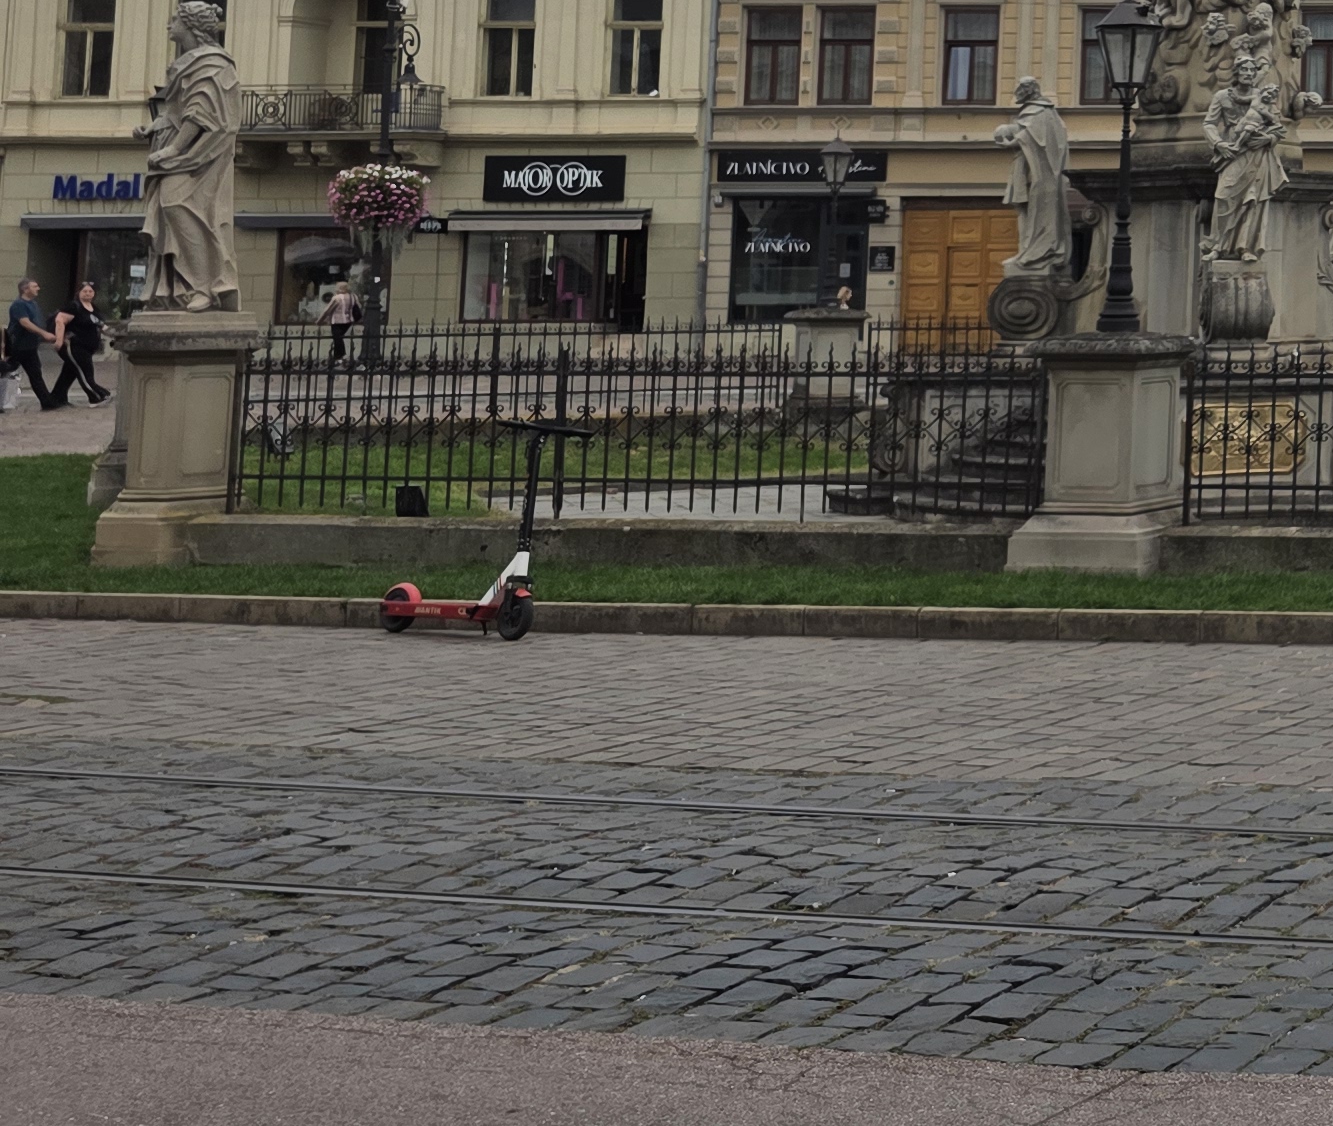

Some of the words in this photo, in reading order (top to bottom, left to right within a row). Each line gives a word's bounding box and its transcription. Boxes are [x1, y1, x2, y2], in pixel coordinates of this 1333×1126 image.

[52, 173, 142, 200] Madal
[502, 168, 551, 190] MAJOR
[557, 167, 604, 188] OPTIK
